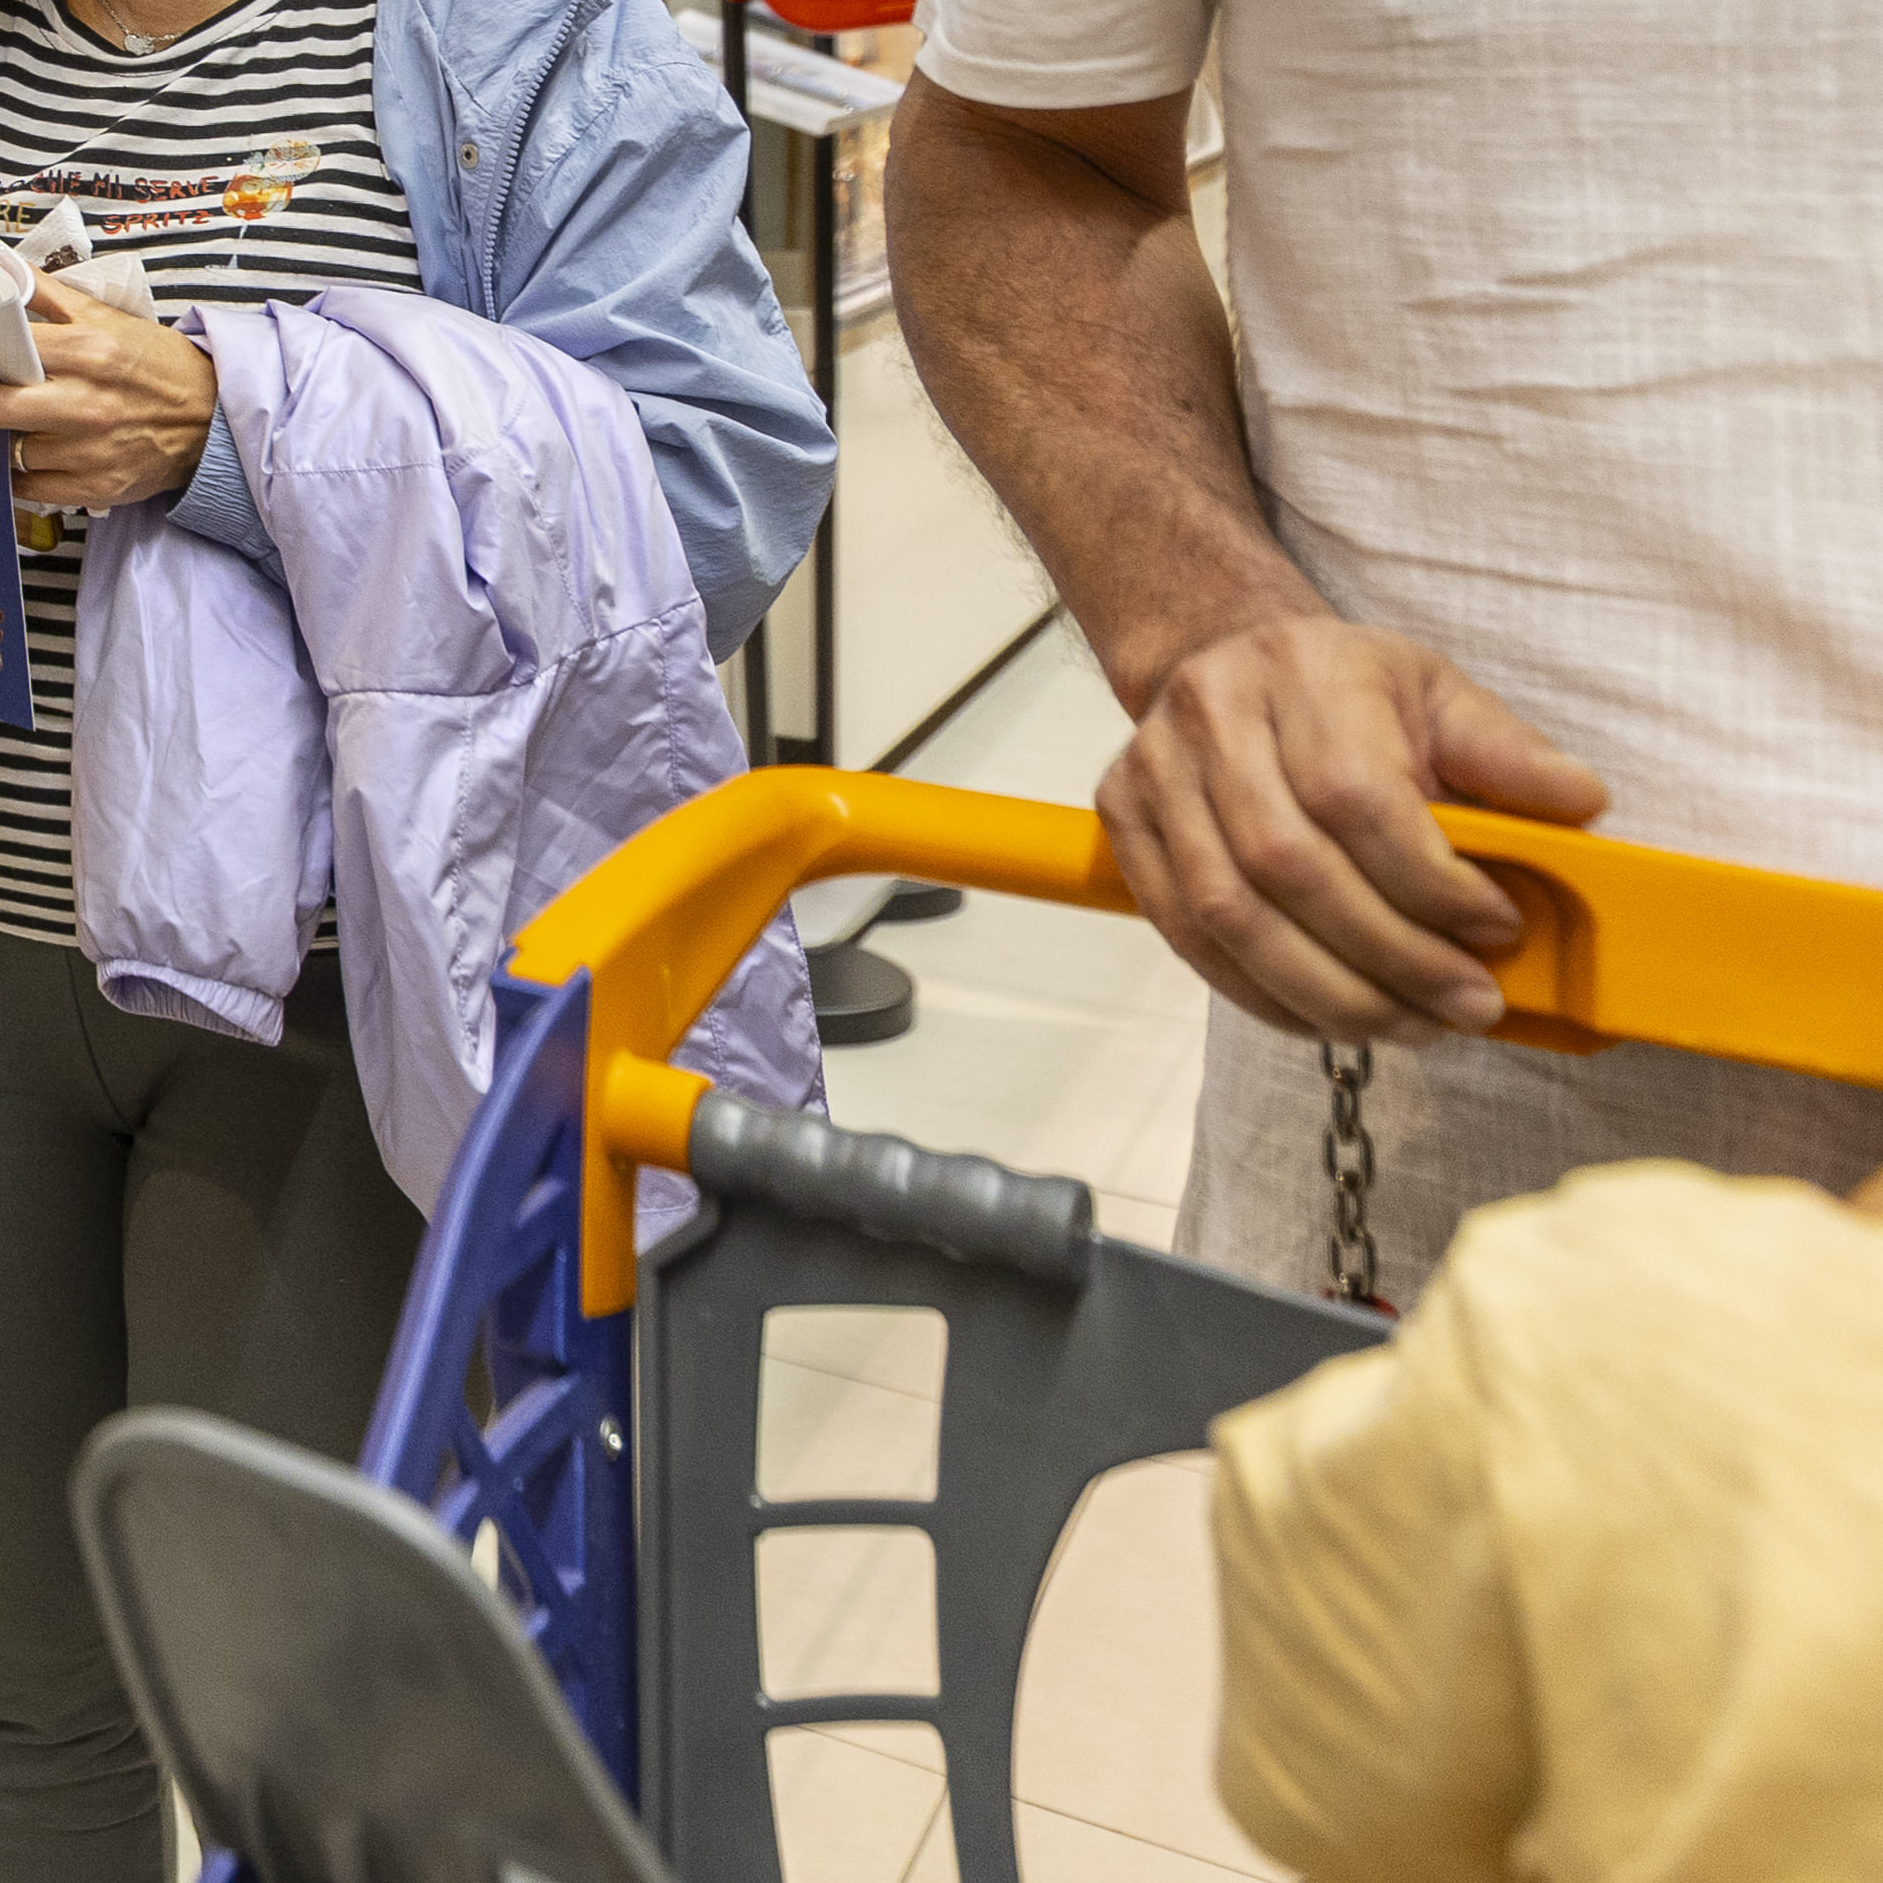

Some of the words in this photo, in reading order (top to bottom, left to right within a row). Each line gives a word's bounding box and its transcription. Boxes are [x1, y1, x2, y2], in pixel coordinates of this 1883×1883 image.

[30, 170, 84, 195] CHE
[93, 172, 122, 199] MI
[134, 175, 220, 204] SERVE
[101, 210, 214, 234] SPRITZ
